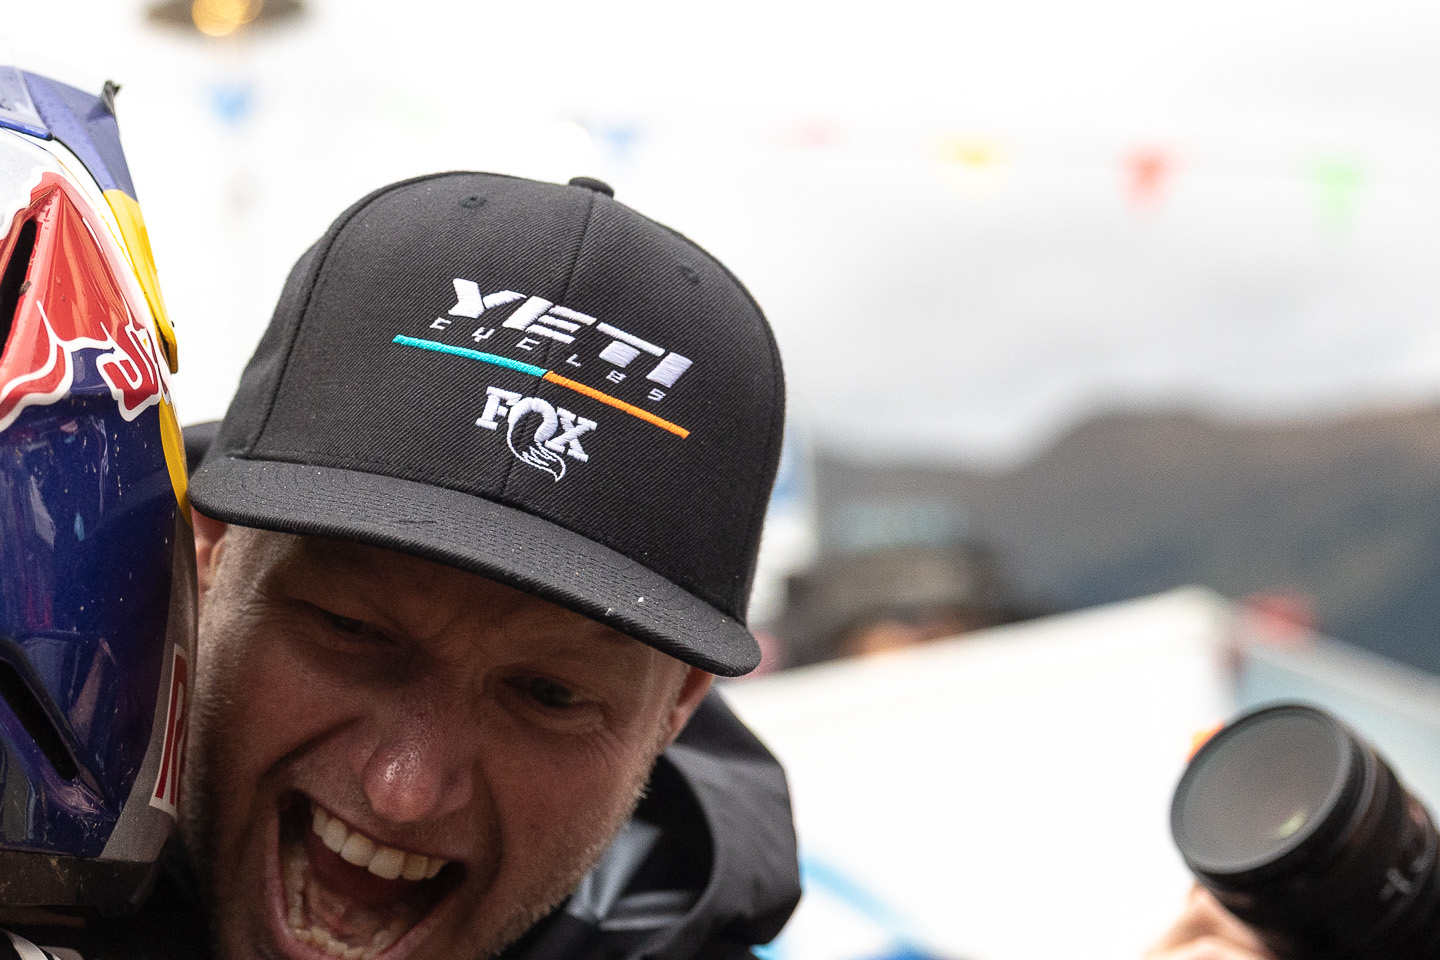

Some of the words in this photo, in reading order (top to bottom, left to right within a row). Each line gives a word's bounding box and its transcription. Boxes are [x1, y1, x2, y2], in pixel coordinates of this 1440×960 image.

[429, 317, 667, 402] CYCLES
[448, 278, 693, 388] YETI
[474, 386, 598, 482] FOX
